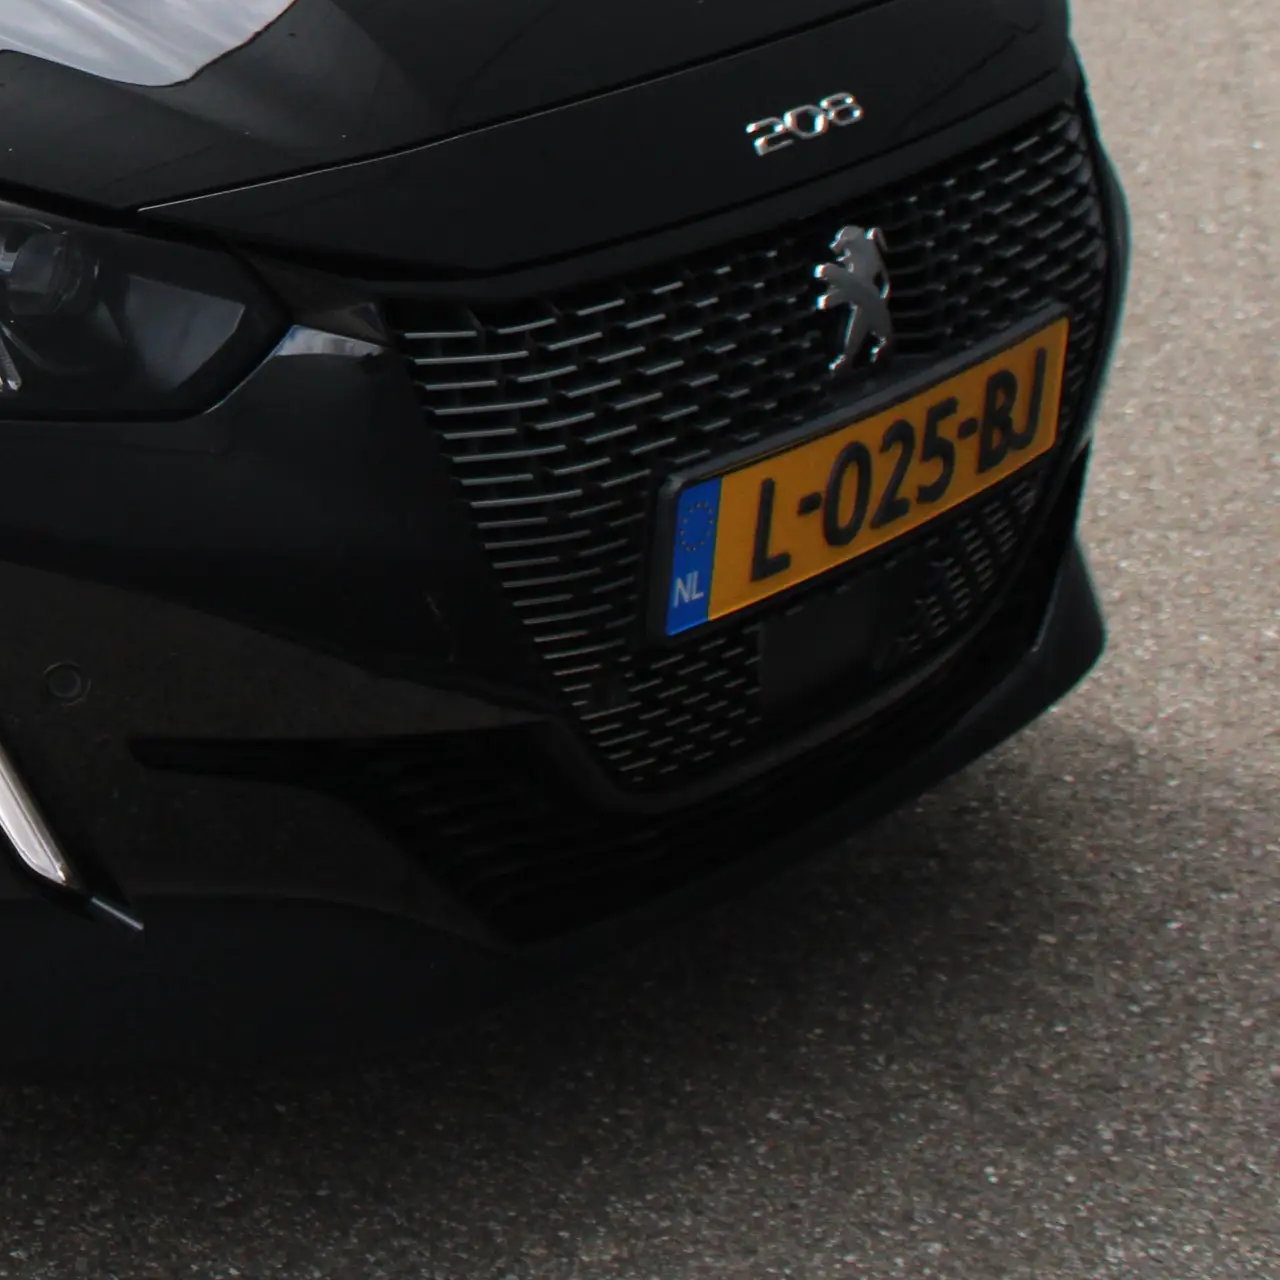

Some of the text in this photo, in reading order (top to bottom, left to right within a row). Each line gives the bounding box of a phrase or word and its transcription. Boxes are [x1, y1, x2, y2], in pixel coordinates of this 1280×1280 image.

[746, 92, 864, 156] 208
[750, 348, 1046, 581] L-025-BJ
[673, 571, 704, 608] NL
